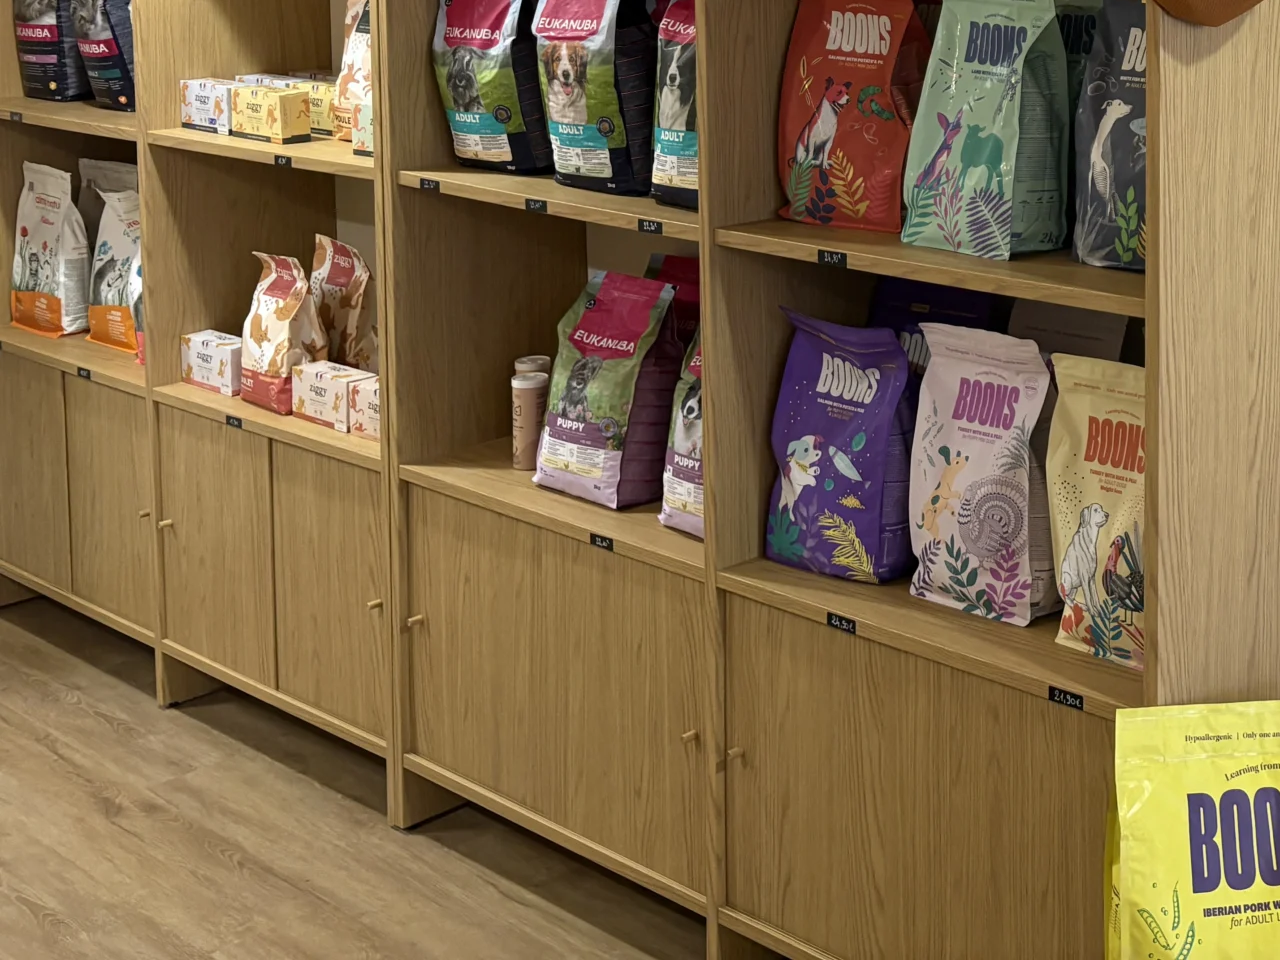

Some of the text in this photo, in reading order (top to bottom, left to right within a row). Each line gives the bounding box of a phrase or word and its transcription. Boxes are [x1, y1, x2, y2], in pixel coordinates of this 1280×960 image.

[538, 18, 598, 30] EUKANUBA
[445, 27, 500, 41] EUKANUBA
[826, 10, 892, 56] BOONS
[964, 21, 1028, 68] BOONS
[156, 94, 172, 106] ziggy
[206, 100, 224, 112] ziggy
[455, 112, 480, 124] ADULT
[558, 124, 584, 135] ADULT
[661, 130, 684, 142] ADULT
[334, 252, 352, 269] ziggy
[574, 330, 635, 353] EUKANUBA
[196, 350, 214, 364] ziggy
[816, 352, 880, 405] BOONS
[310, 382, 328, 398] ziggy
[952, 376, 1020, 431] BOONS
[557, 418, 585, 432] PUPPY
[675, 455, 700, 470] PUPPY
[1054, 690, 1082, 707] 21,90€
[1184, 733, 1232, 744] Hypoallergenic
[1242, 730, 1258, 740] Only
[1225, 765, 1259, 782] Learning
[1260, 762, 1280, 772] from
[1203, 904, 1242, 918] IBERIAN
[1243, 902, 1272, 914] PORK
[1230, 914, 1243, 930] for
[1245, 912, 1273, 927] ADULT
